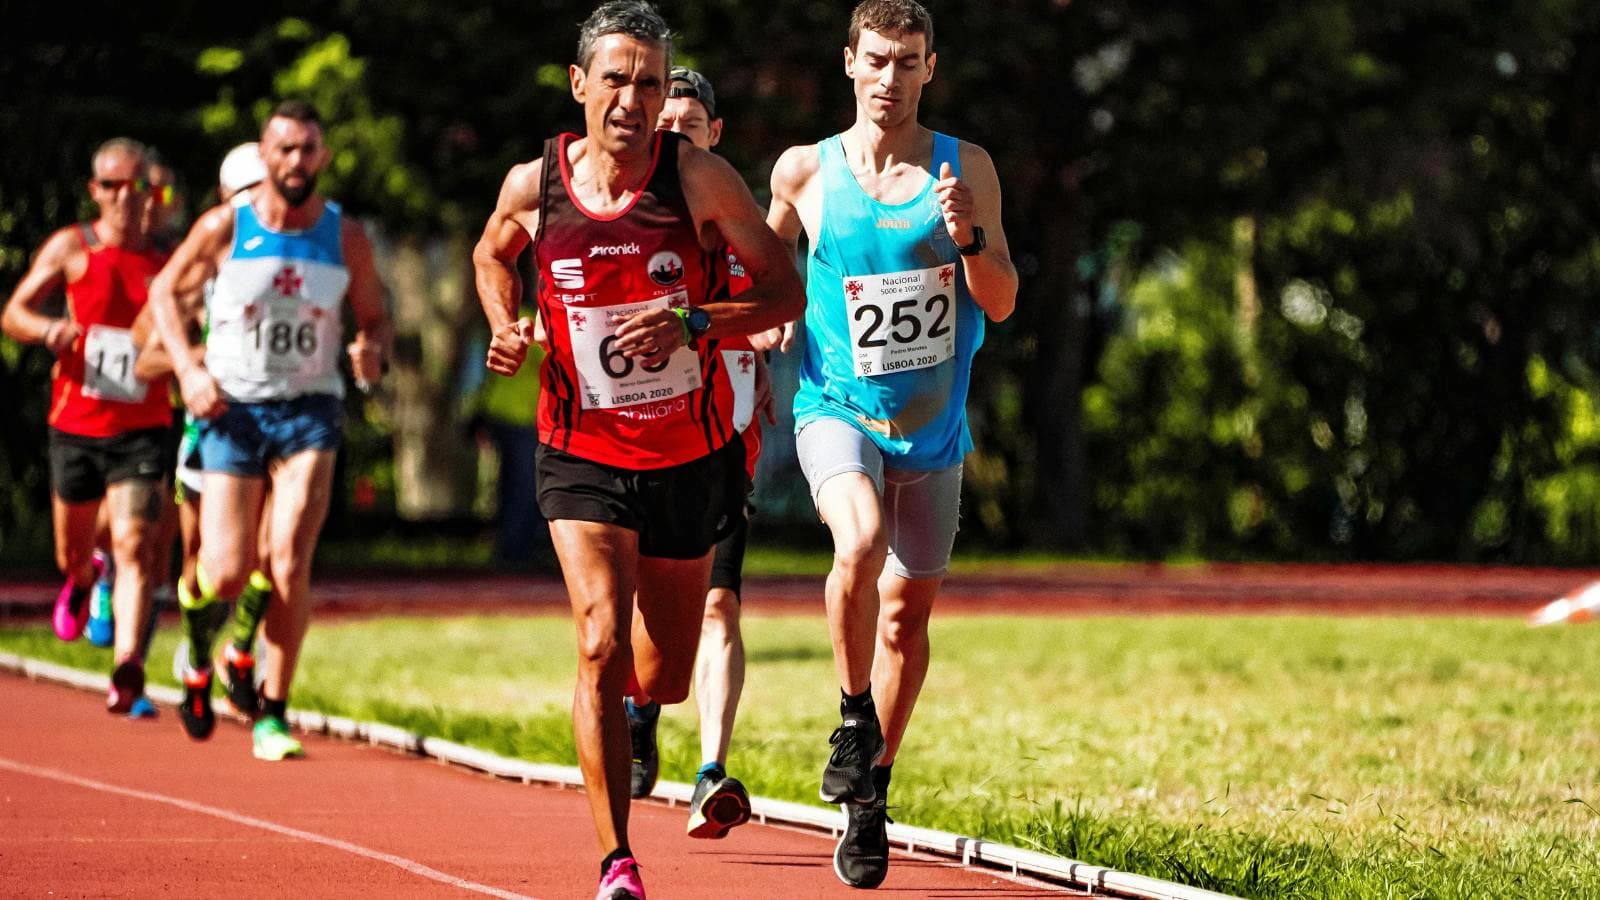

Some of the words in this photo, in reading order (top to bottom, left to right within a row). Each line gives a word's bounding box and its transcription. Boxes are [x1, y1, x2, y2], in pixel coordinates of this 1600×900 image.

[882, 274, 921, 286] Nacional
[880, 287, 897, 295] 5000
[854, 294, 951, 348] 252
[247, 319, 317, 357] 186
[882, 359, 915, 371] LISBOA
[917, 355, 937, 365] 2020
[611, 392, 647, 405] LISBOA
[649, 387, 674, 399] 2020
